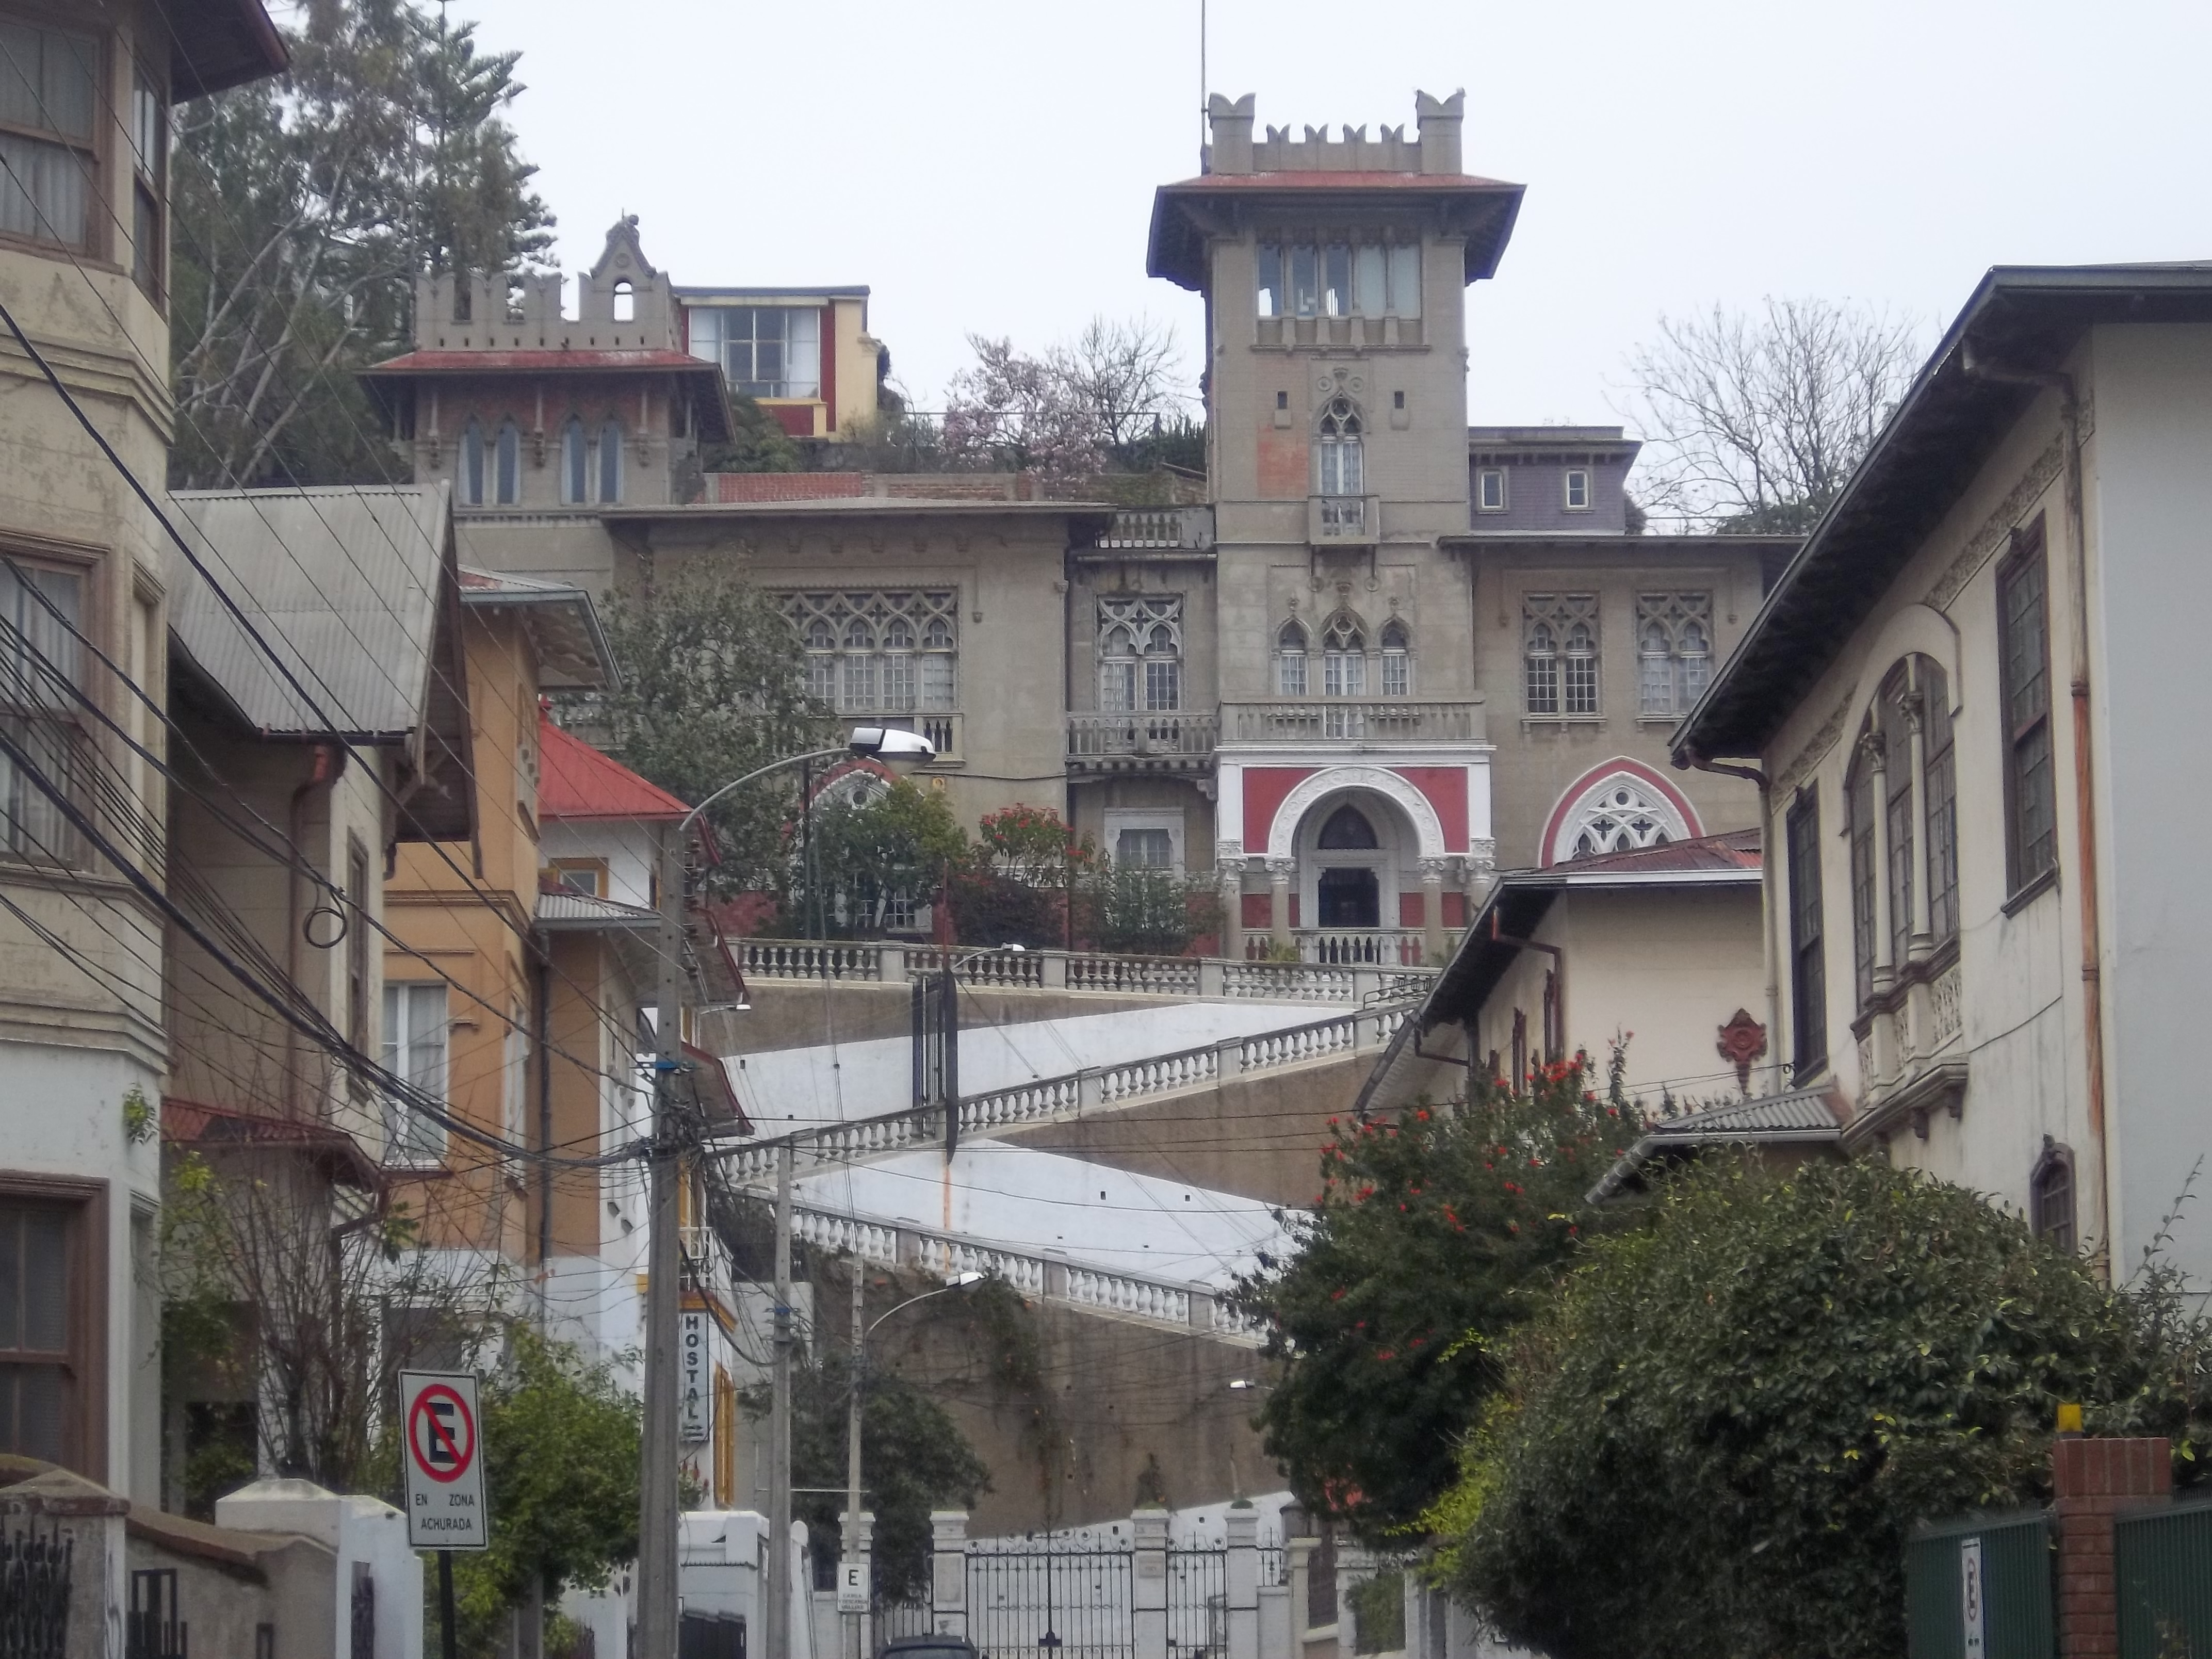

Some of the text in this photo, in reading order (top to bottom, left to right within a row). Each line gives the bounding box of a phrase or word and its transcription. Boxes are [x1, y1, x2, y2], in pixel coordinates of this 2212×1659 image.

[686, 1315, 698, 1420] HOSTAL
[416, 1494, 474, 1506] EN ZONA
[421, 1518, 471, 1530] ACHURADA
[849, 1569, 859, 1586] E
